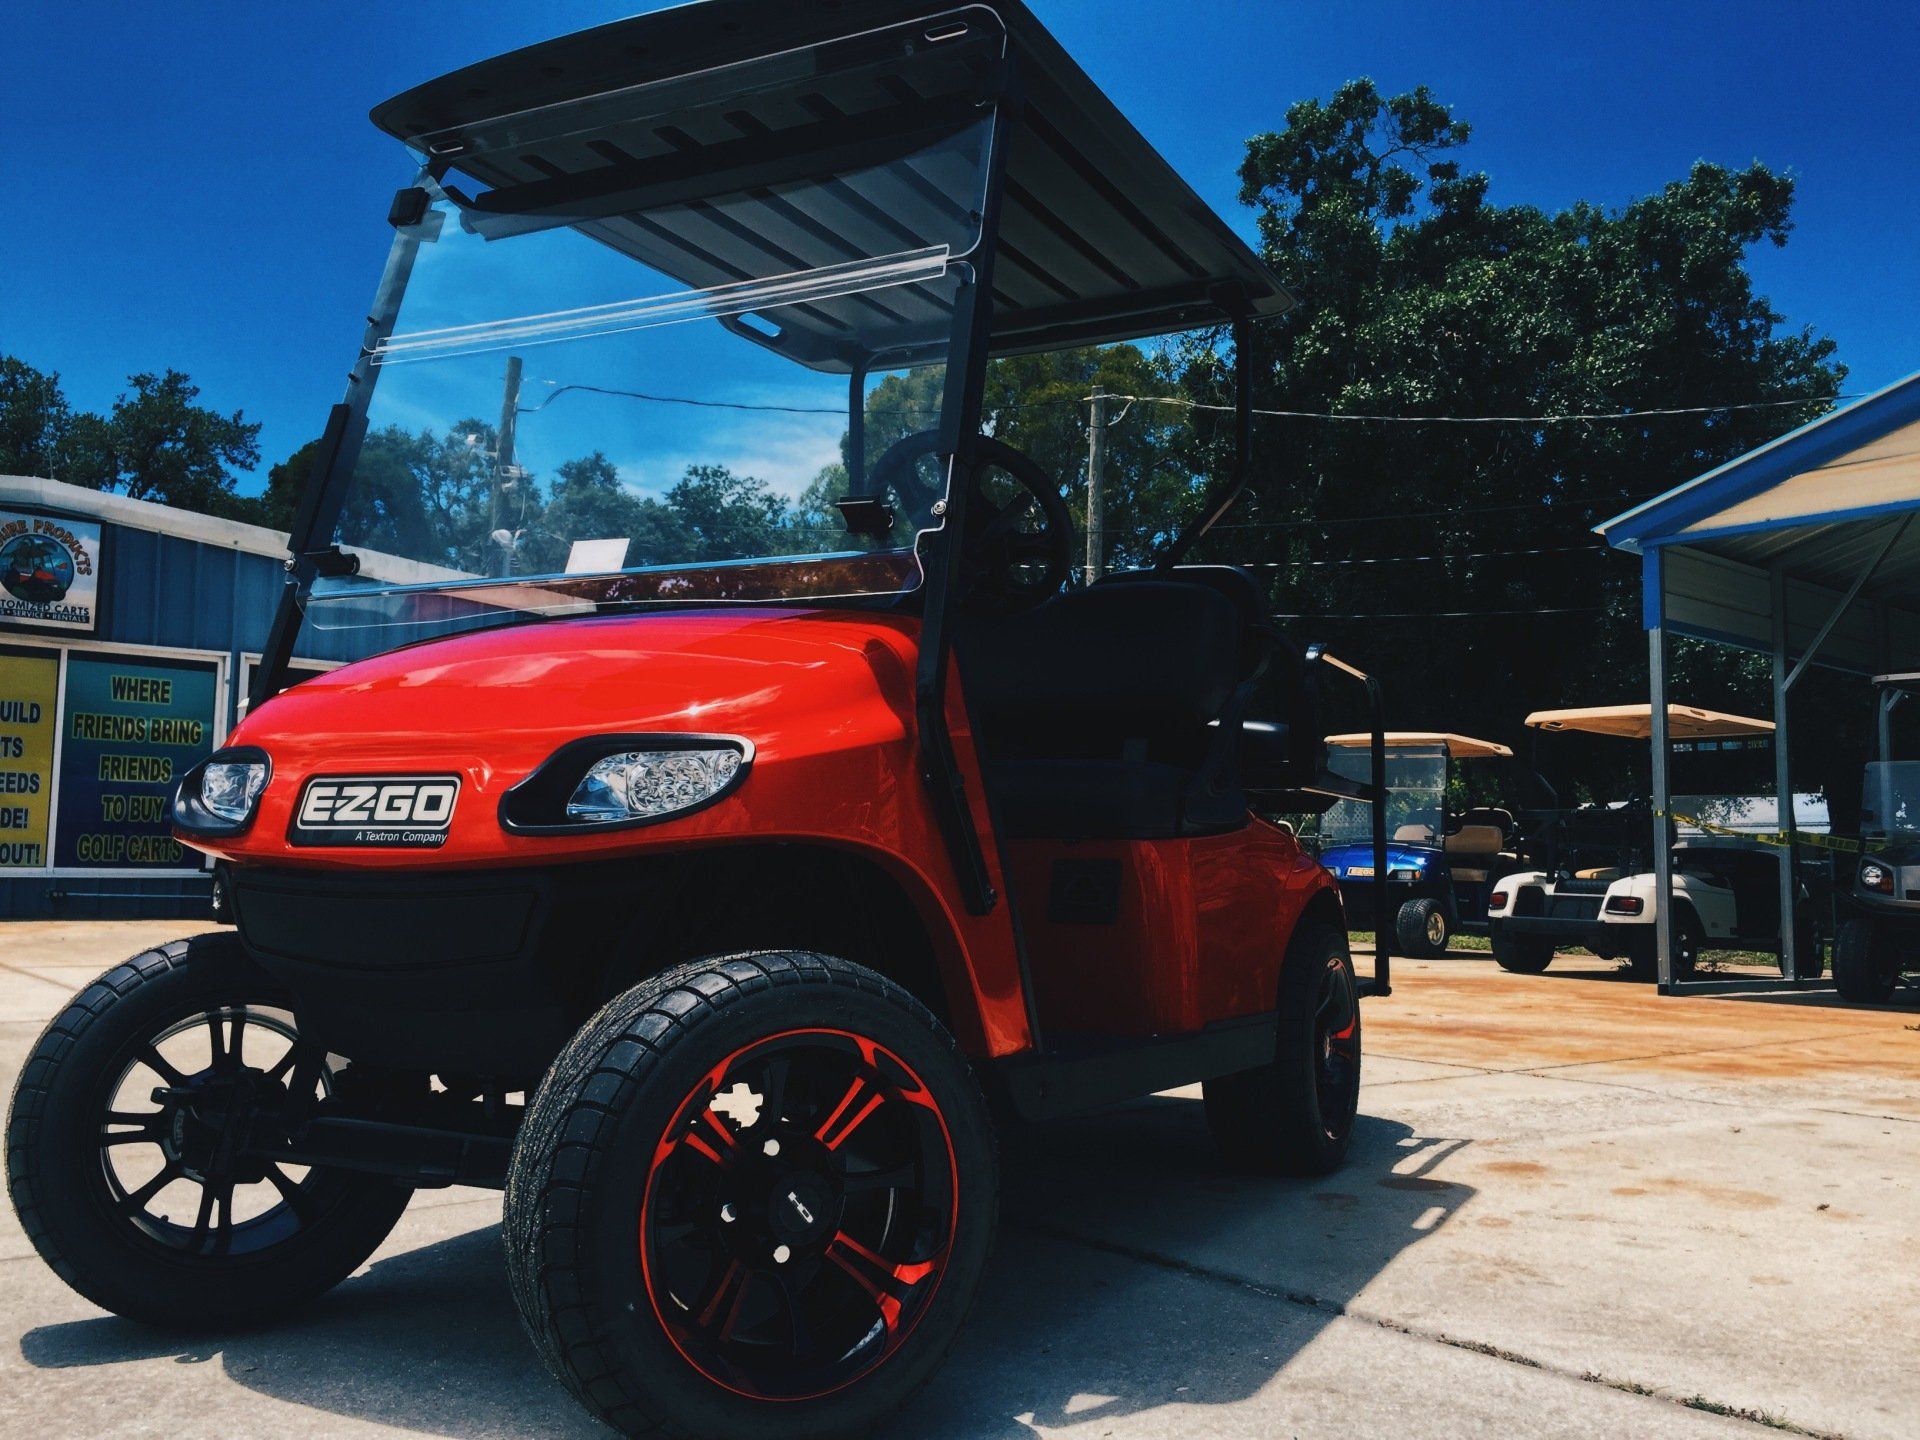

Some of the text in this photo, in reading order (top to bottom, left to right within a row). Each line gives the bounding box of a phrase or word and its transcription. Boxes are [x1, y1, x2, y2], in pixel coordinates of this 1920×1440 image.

[12, 609, 45, 619] SERVICE
[52, 612, 87, 623] RENTALS
[55, 604, 90, 616] CARTS
[111, 675, 172, 704] WHERE
[72, 713, 202, 745] FRIENDS BRING
[99, 755, 172, 783] FRIENDS
[102, 794, 167, 823] TO BUY
[77, 834, 183, 863] GOLF CARTS
[355, 831, 448, 843] A Textron Company
